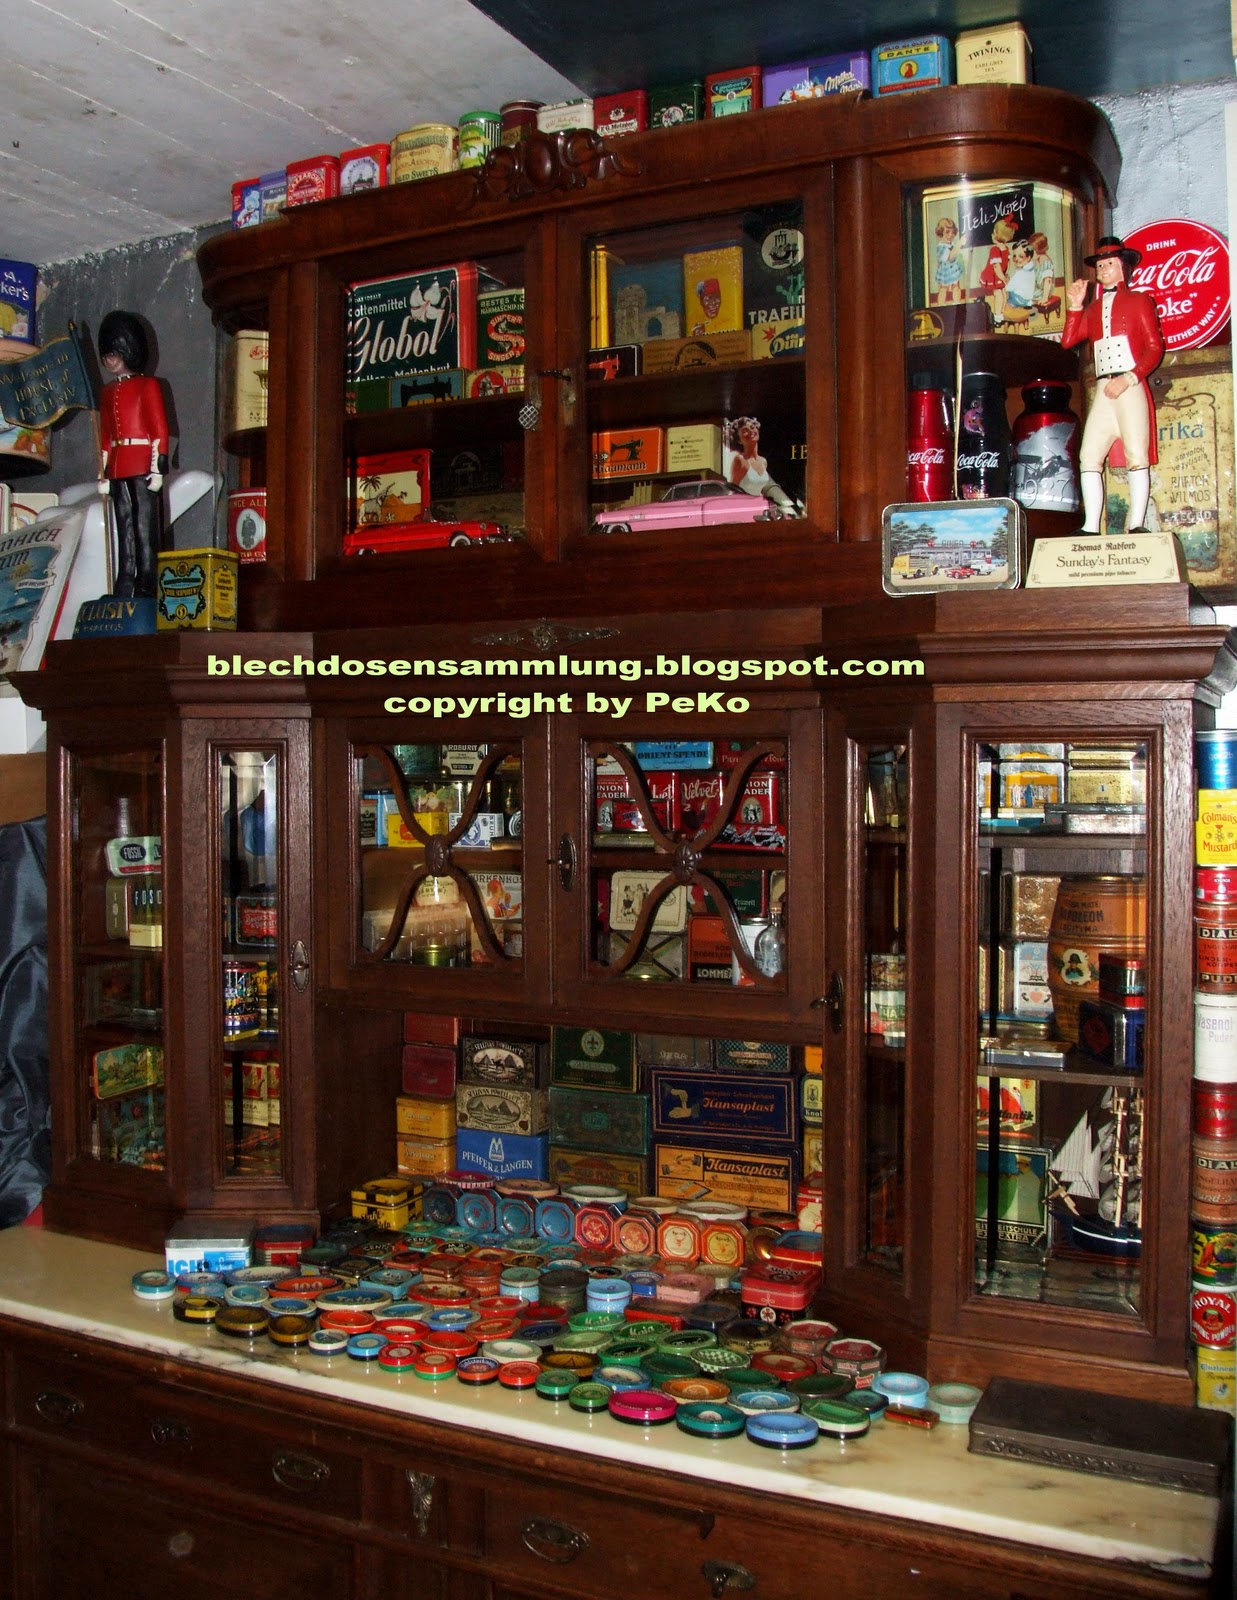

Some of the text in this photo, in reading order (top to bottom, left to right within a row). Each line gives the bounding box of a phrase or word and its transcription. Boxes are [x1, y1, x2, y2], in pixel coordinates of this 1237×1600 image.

[886, 46, 931, 58] DANTE
[967, 46, 1012, 61] TWININGS
[824, 70, 856, 91] Milka
[1146, 238, 1177, 252] DRINK
[1128, 246, 1220, 291] ca-Cola
[354, 296, 407, 317] ottenmittel
[1167, 325, 1200, 344] EITHER
[1199, 308, 1217, 327] WAY
[1159, 421, 1204, 441] rika
[1071, 541, 1136, 552] Thomas Radford
[1056, 553, 1152, 569] Sunday's Fantasy
[1081, 571, 1103, 579] premium
[1104, 571, 1115, 579] pipe
[597, 784, 624, 792] NION
[597, 791, 627, 799] EADER
[682, 778, 720, 800] Velvet
[1201, 811, 1237, 825] Colman's
[123, 846, 144, 859] FOSSIL
[1202, 839, 1237, 853] Mustard
[703, 1097, 775, 1113] Hansaplast
[462, 1150, 492, 1172] PFEIFER
[500, 1159, 533, 1174] LANGEN
[706, 1158, 786, 1178] Hansaplast
[998, 1224, 1038, 1235] EITSCHULE
[999, 1232, 1030, 1244] EXTRA
[1193, 1296, 1231, 1314] ROYAL
